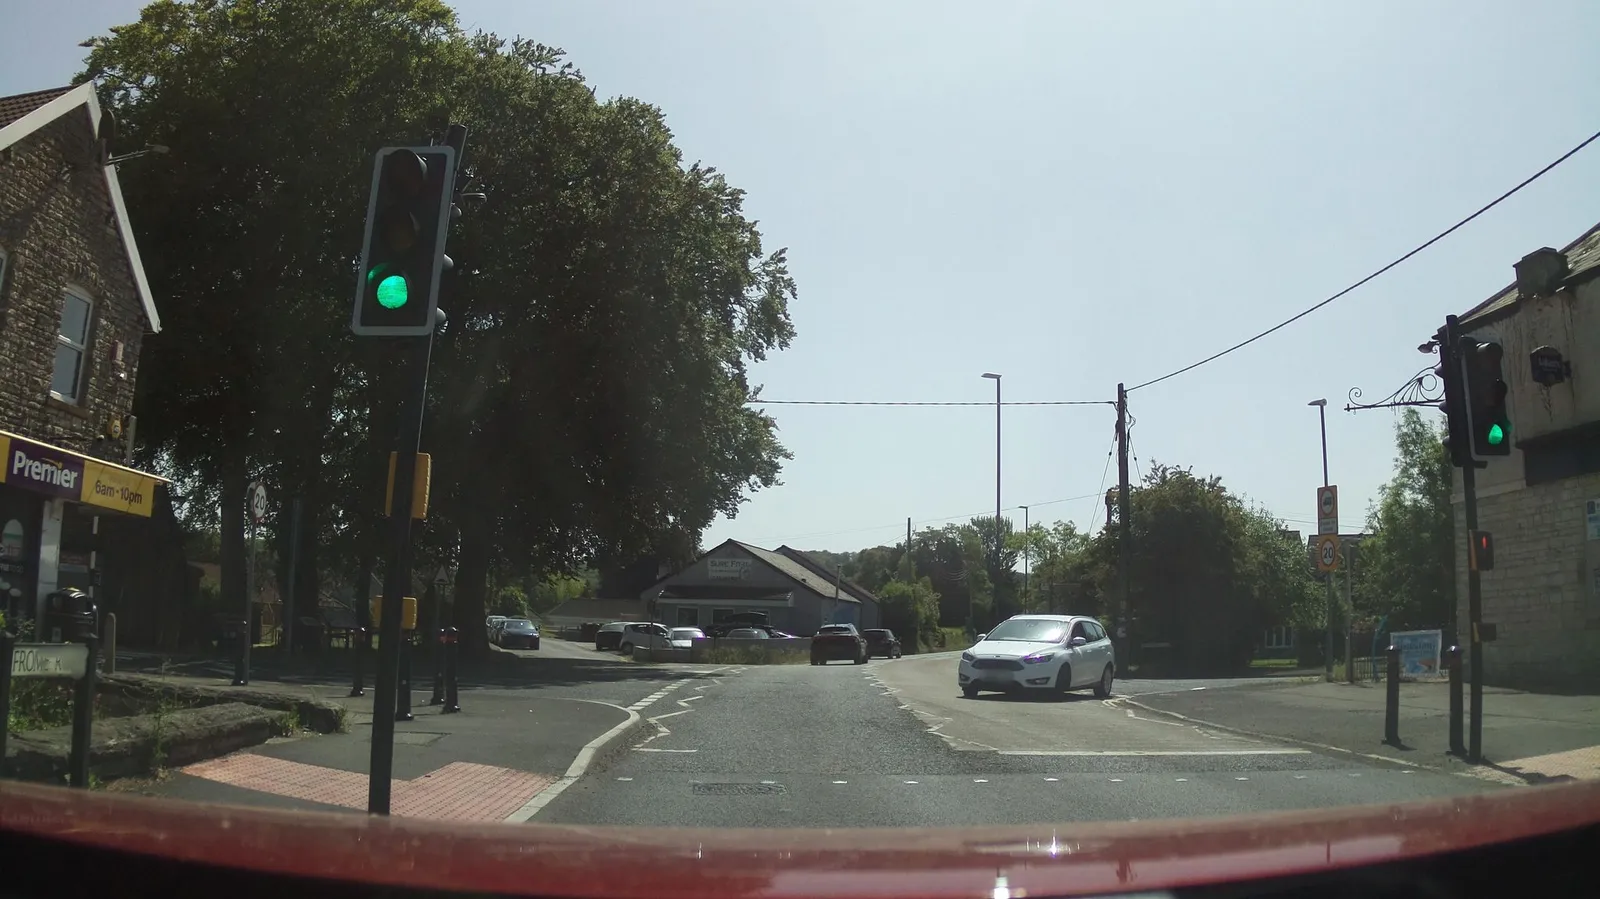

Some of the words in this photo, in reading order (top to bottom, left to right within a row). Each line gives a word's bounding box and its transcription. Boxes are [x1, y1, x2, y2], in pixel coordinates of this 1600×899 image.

[12, 450, 78, 489] Premier
[254, 492, 265, 510] 20
[1323, 547, 1334, 559] 20
